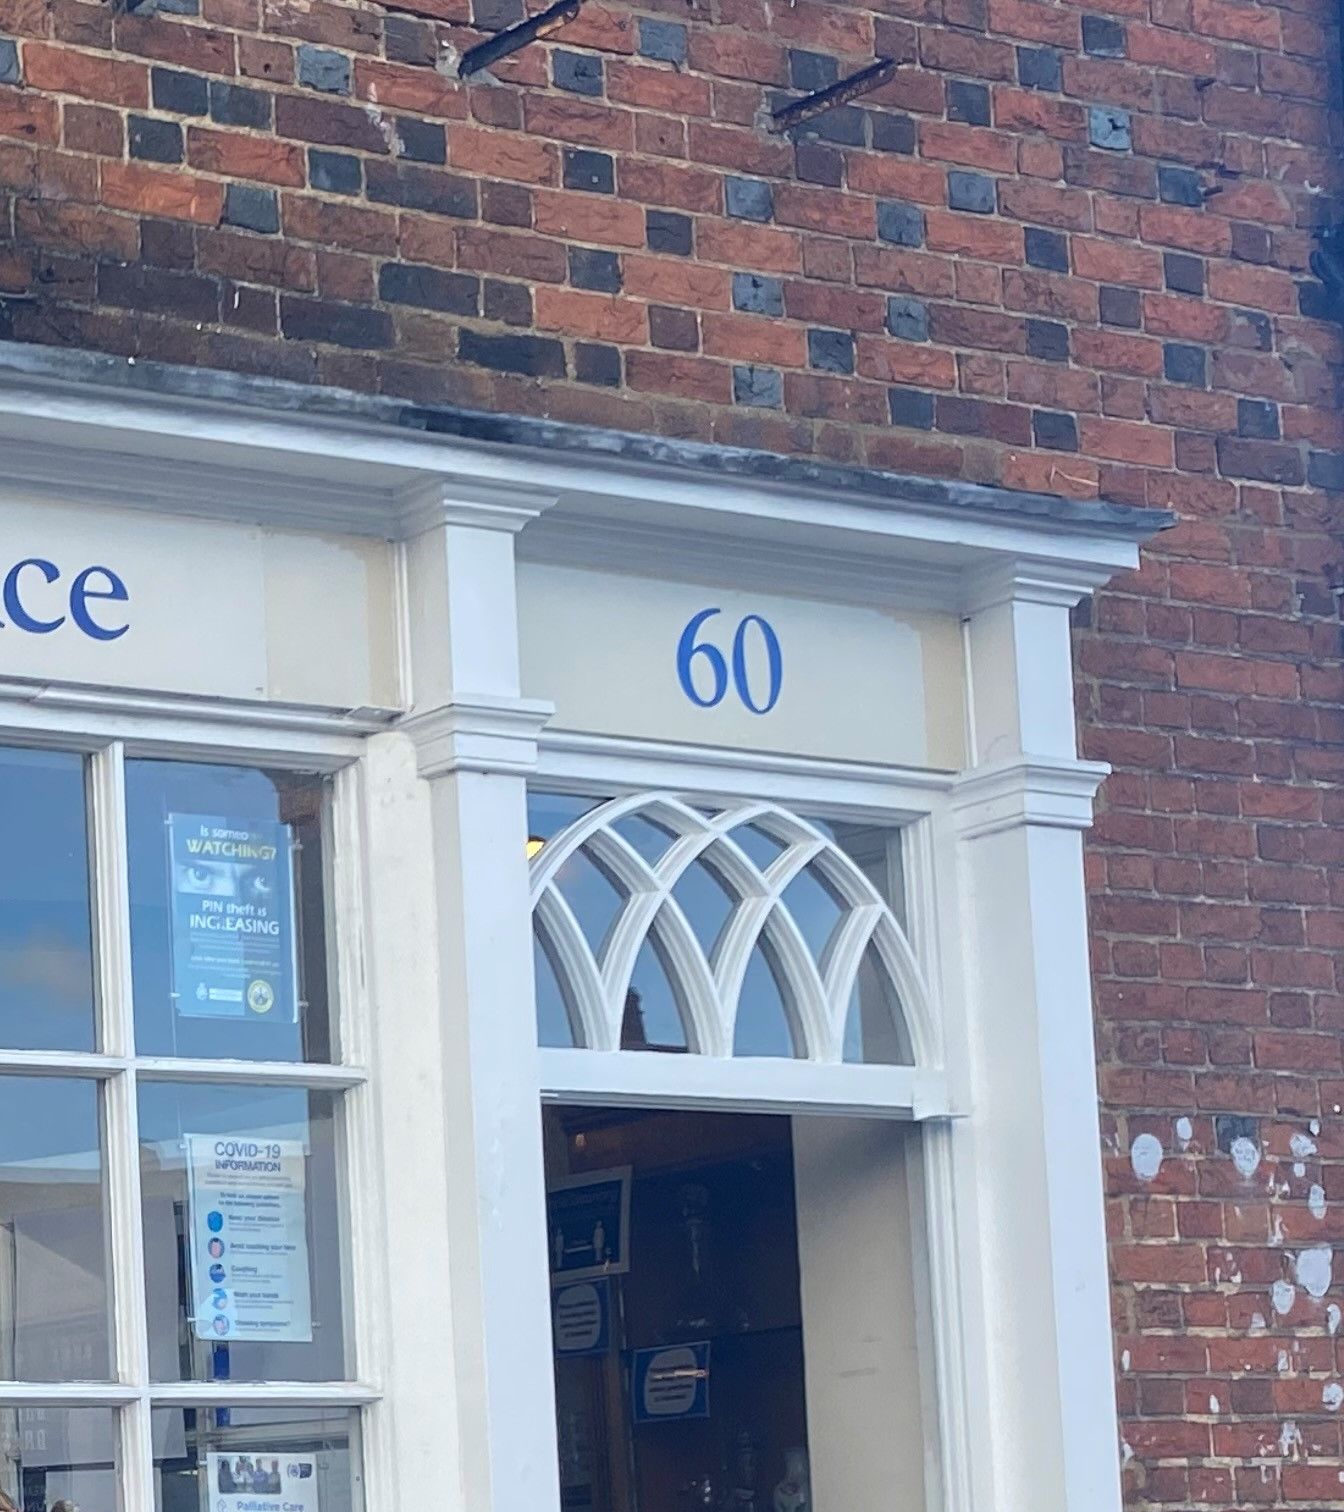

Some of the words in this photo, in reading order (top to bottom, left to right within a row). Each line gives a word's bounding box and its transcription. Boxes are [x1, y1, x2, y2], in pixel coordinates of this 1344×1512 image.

[676, 607, 783, 715] 60
[202, 900, 223, 913] PIN
[226, 902, 254, 916] theft
[214, 1141, 281, 1159] COVID-19
[215, 1159, 281, 1172] INFORMATION
[237, 1500, 280, 1512] Palliative
[282, 1502, 305, 1512] Care
